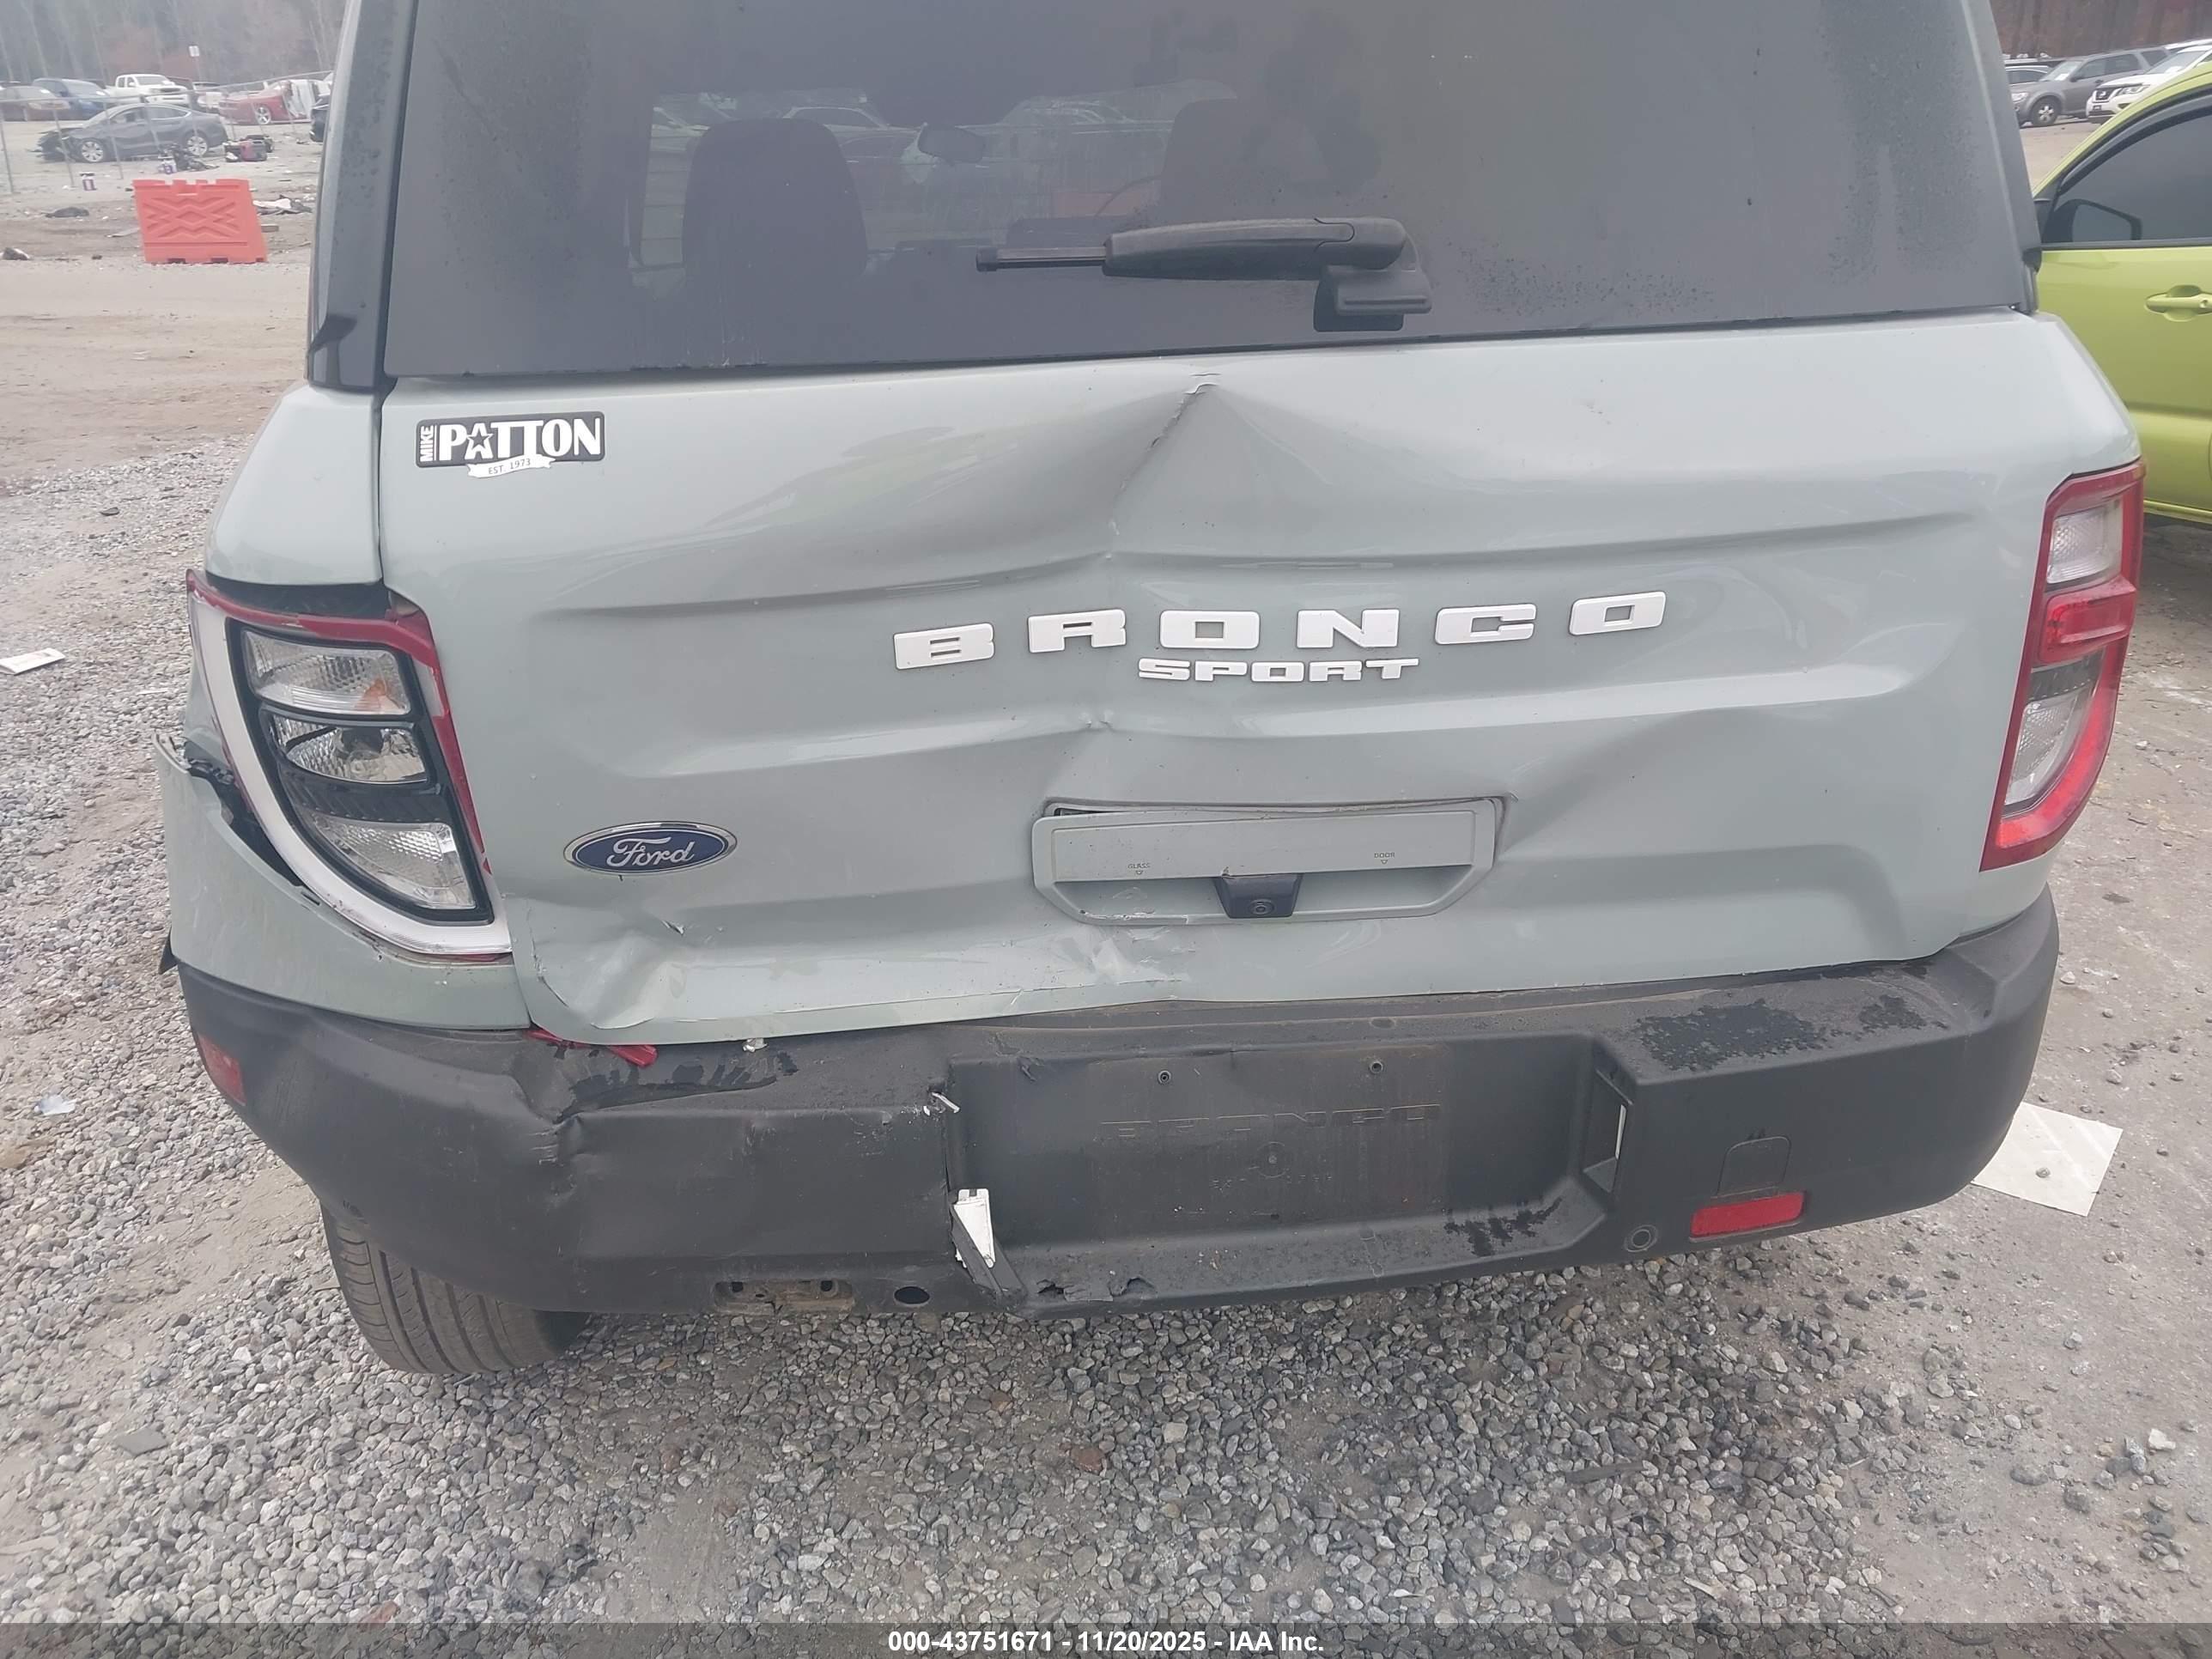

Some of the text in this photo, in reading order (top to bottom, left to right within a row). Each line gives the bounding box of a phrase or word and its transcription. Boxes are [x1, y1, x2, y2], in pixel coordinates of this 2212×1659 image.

[420, 425, 434, 462] MIKE
[439, 417, 601, 461] PATTON
[488, 458, 531, 475] EST. 1973
[894, 591, 1666, 670] BRONCO
[1138, 658, 1419, 682] SPORT
[606, 836, 696, 866] Ford
